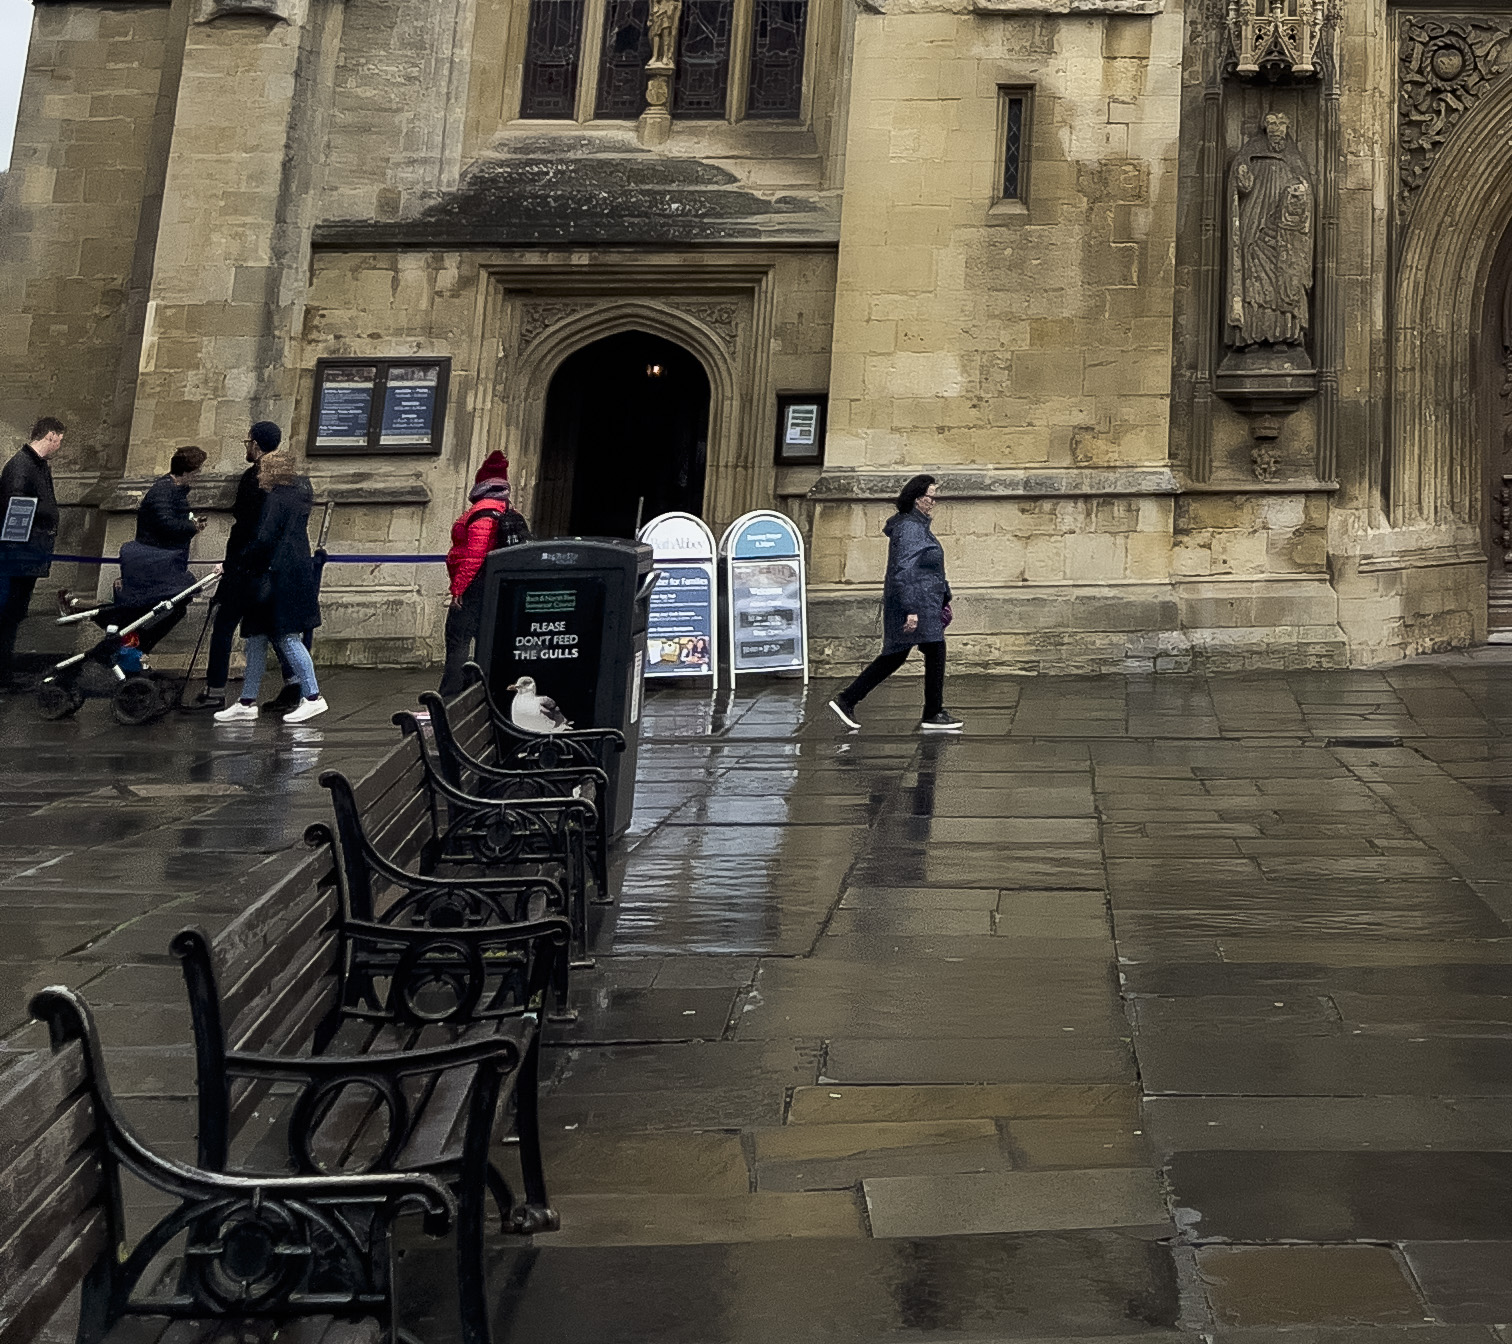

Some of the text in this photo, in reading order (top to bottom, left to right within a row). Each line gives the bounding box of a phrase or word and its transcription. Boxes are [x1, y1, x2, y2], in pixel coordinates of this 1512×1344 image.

[530, 621, 566, 632] PLEASE
[515, 634, 579, 646] DON'T FEED
[513, 648, 579, 660] THE GULLS
